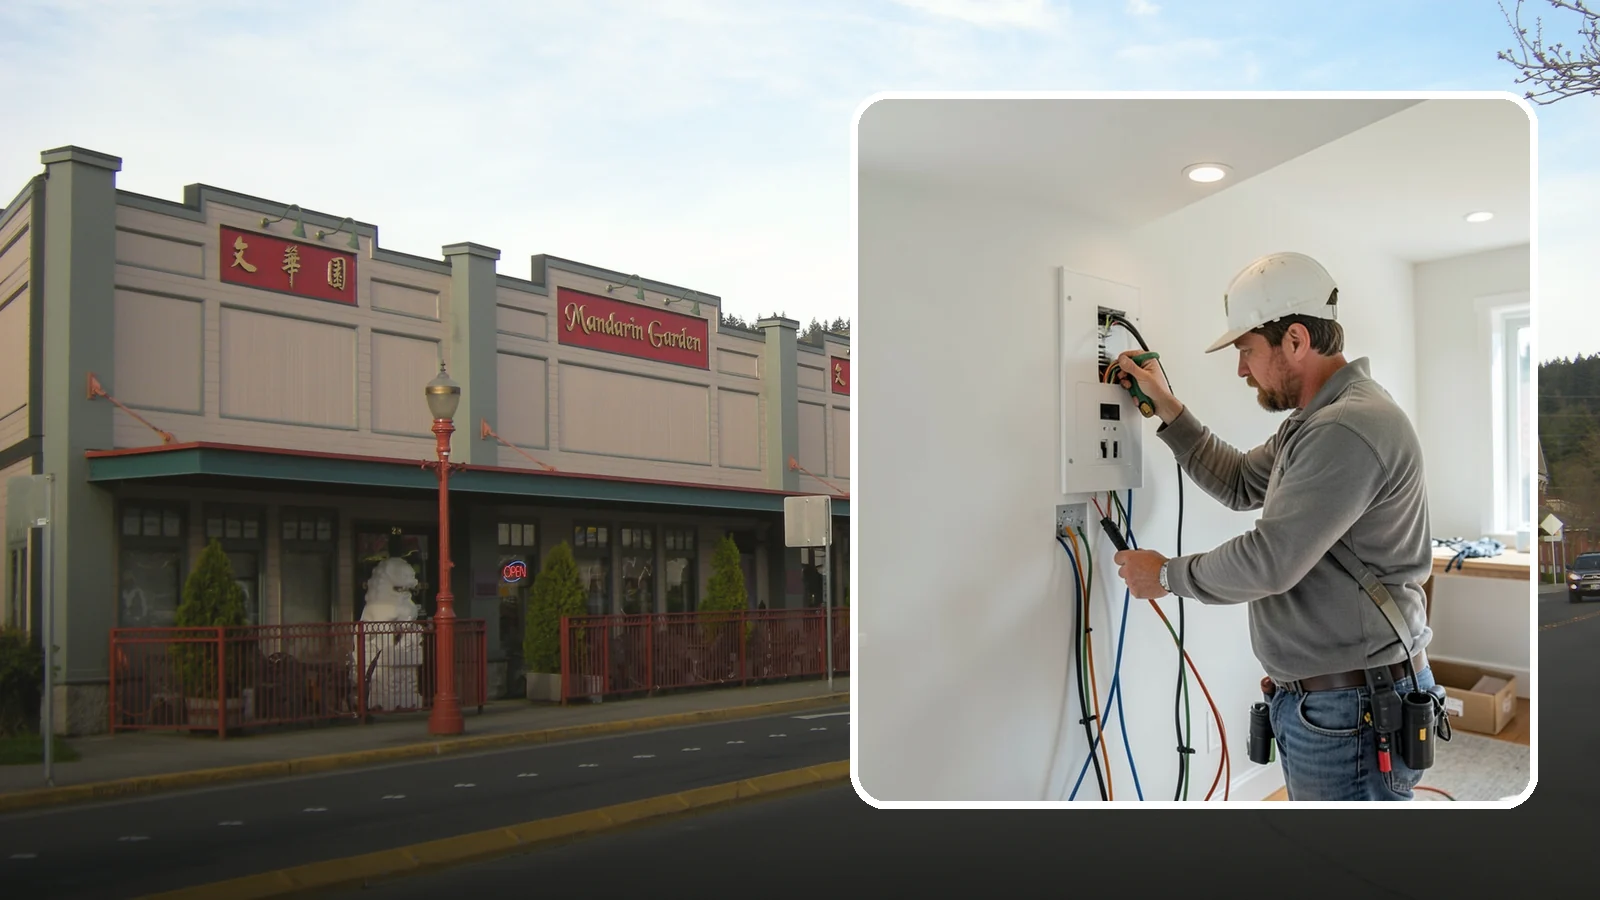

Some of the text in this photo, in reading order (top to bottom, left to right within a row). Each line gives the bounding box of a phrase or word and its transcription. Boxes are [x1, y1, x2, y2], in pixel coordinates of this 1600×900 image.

[565, 303, 701, 352] Mandarin Garden
[503, 565, 527, 578] OPEN
